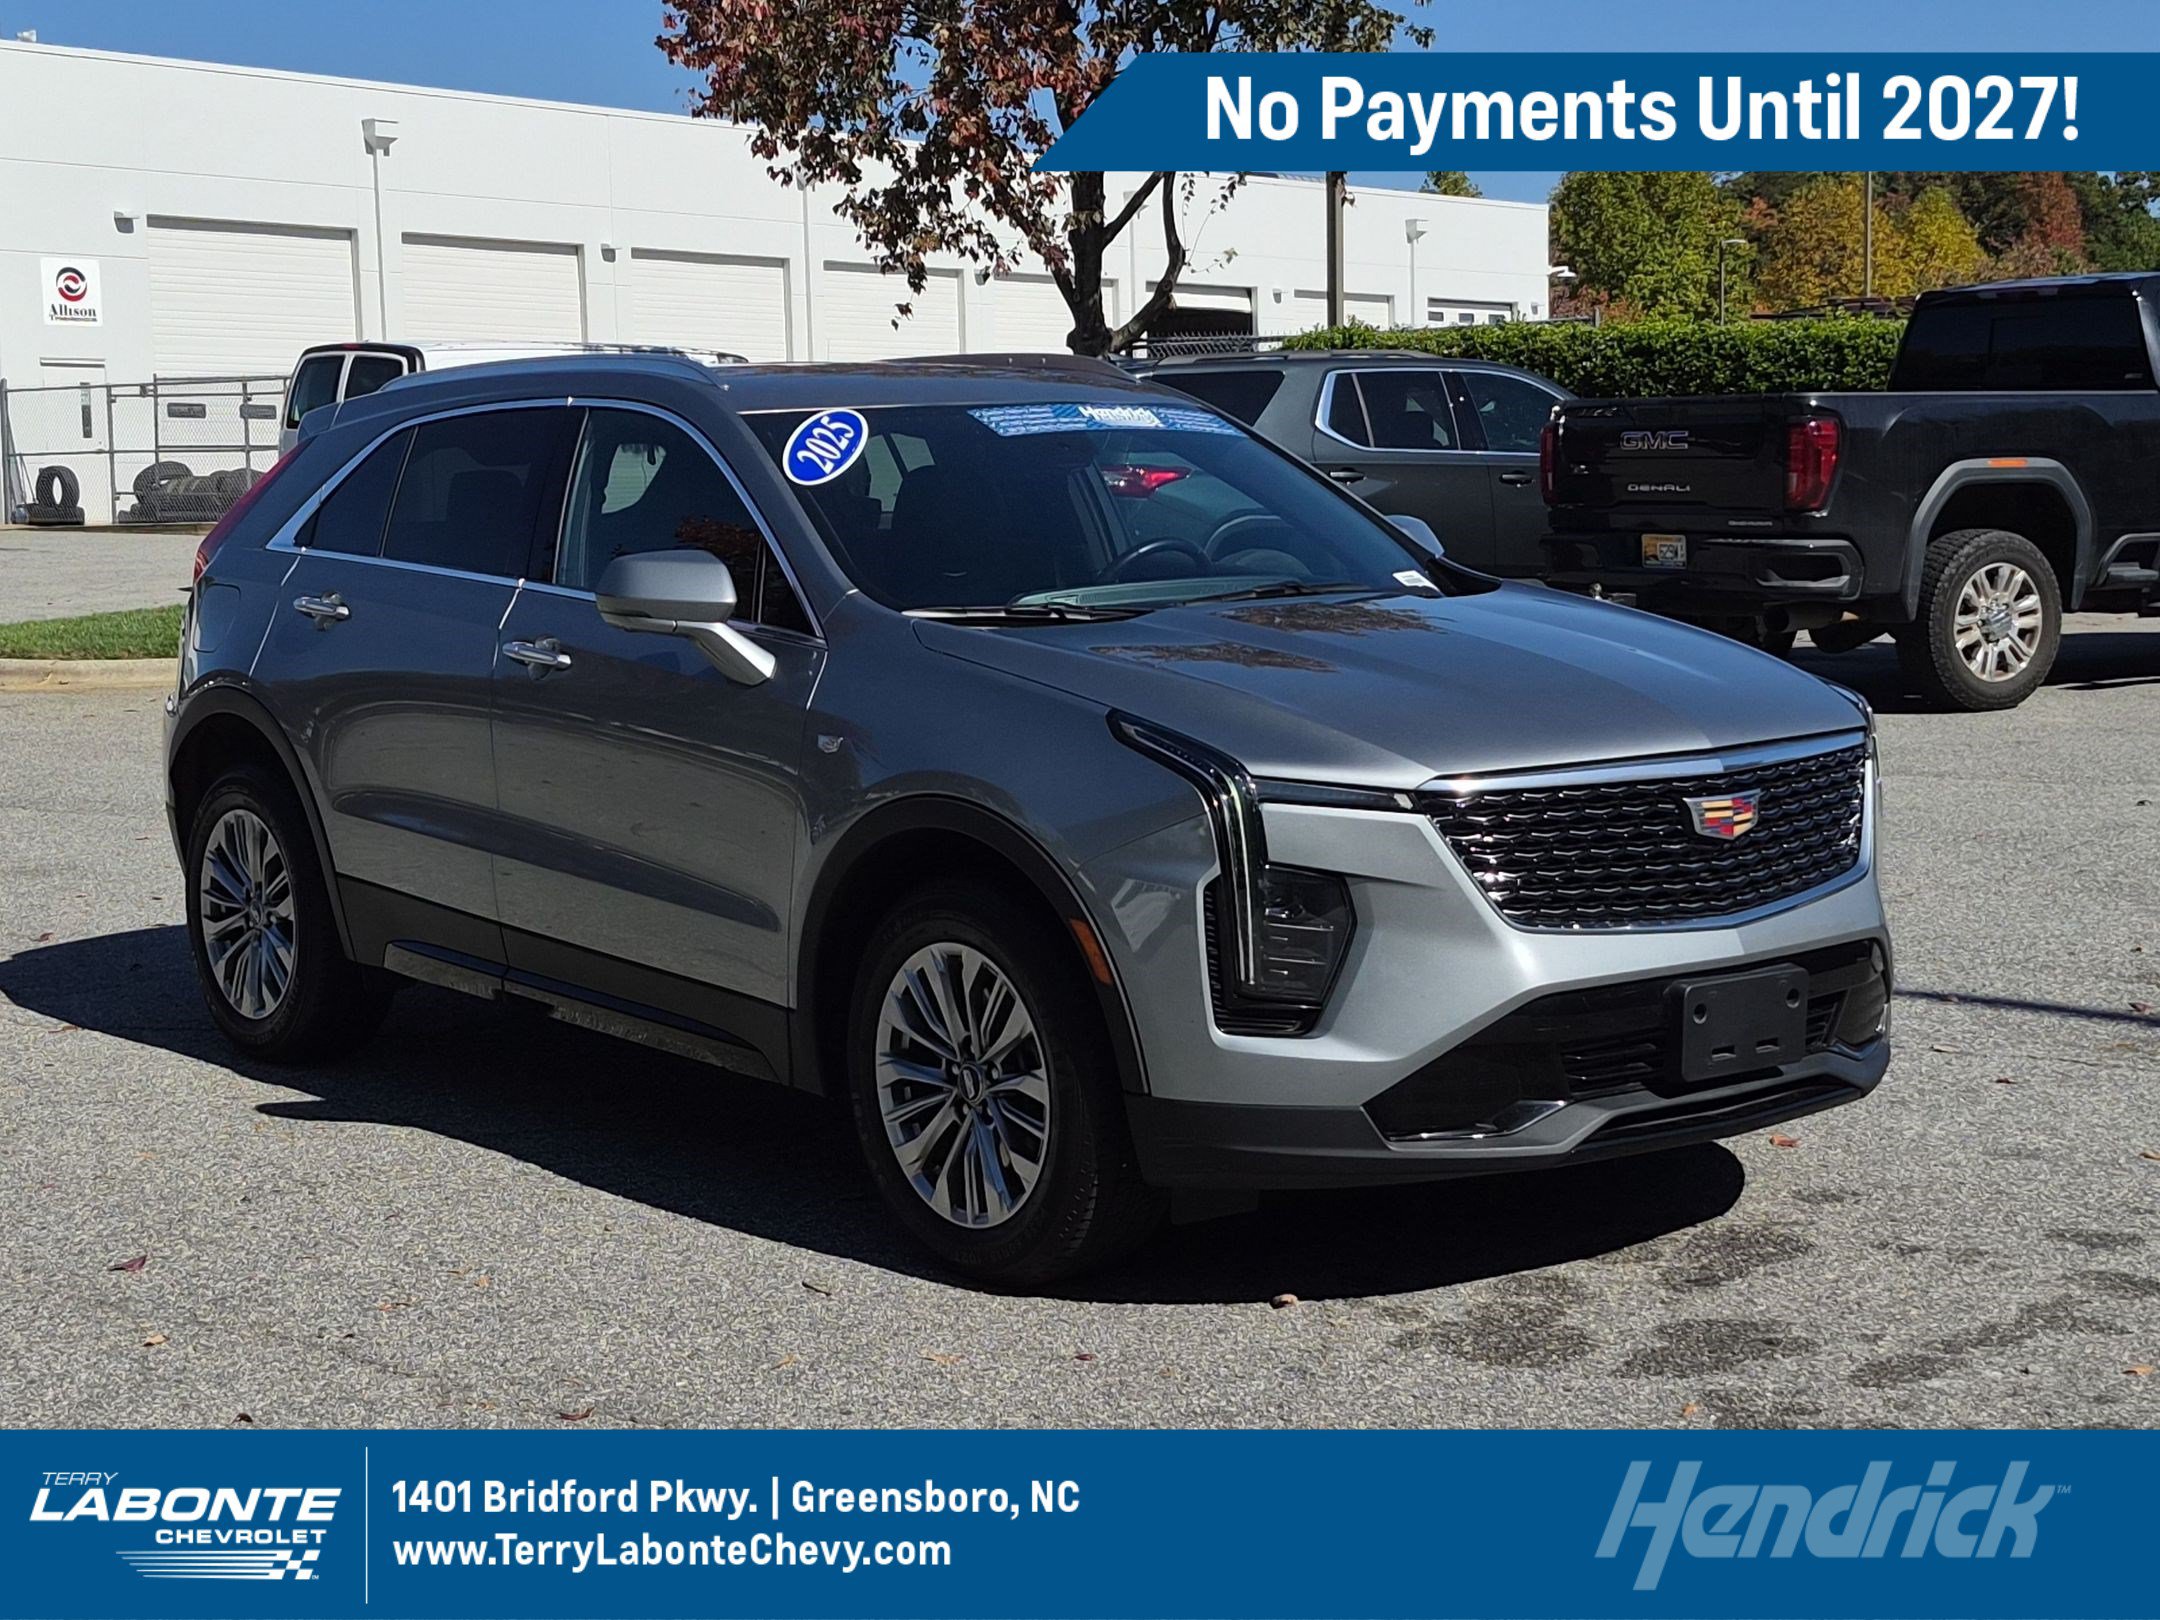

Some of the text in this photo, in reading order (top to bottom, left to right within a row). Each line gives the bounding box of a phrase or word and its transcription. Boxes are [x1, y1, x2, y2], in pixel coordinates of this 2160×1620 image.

[50, 303, 97, 317] Allison
[796, 415, 855, 475] 2025
[1620, 431, 1689, 450] GMC
